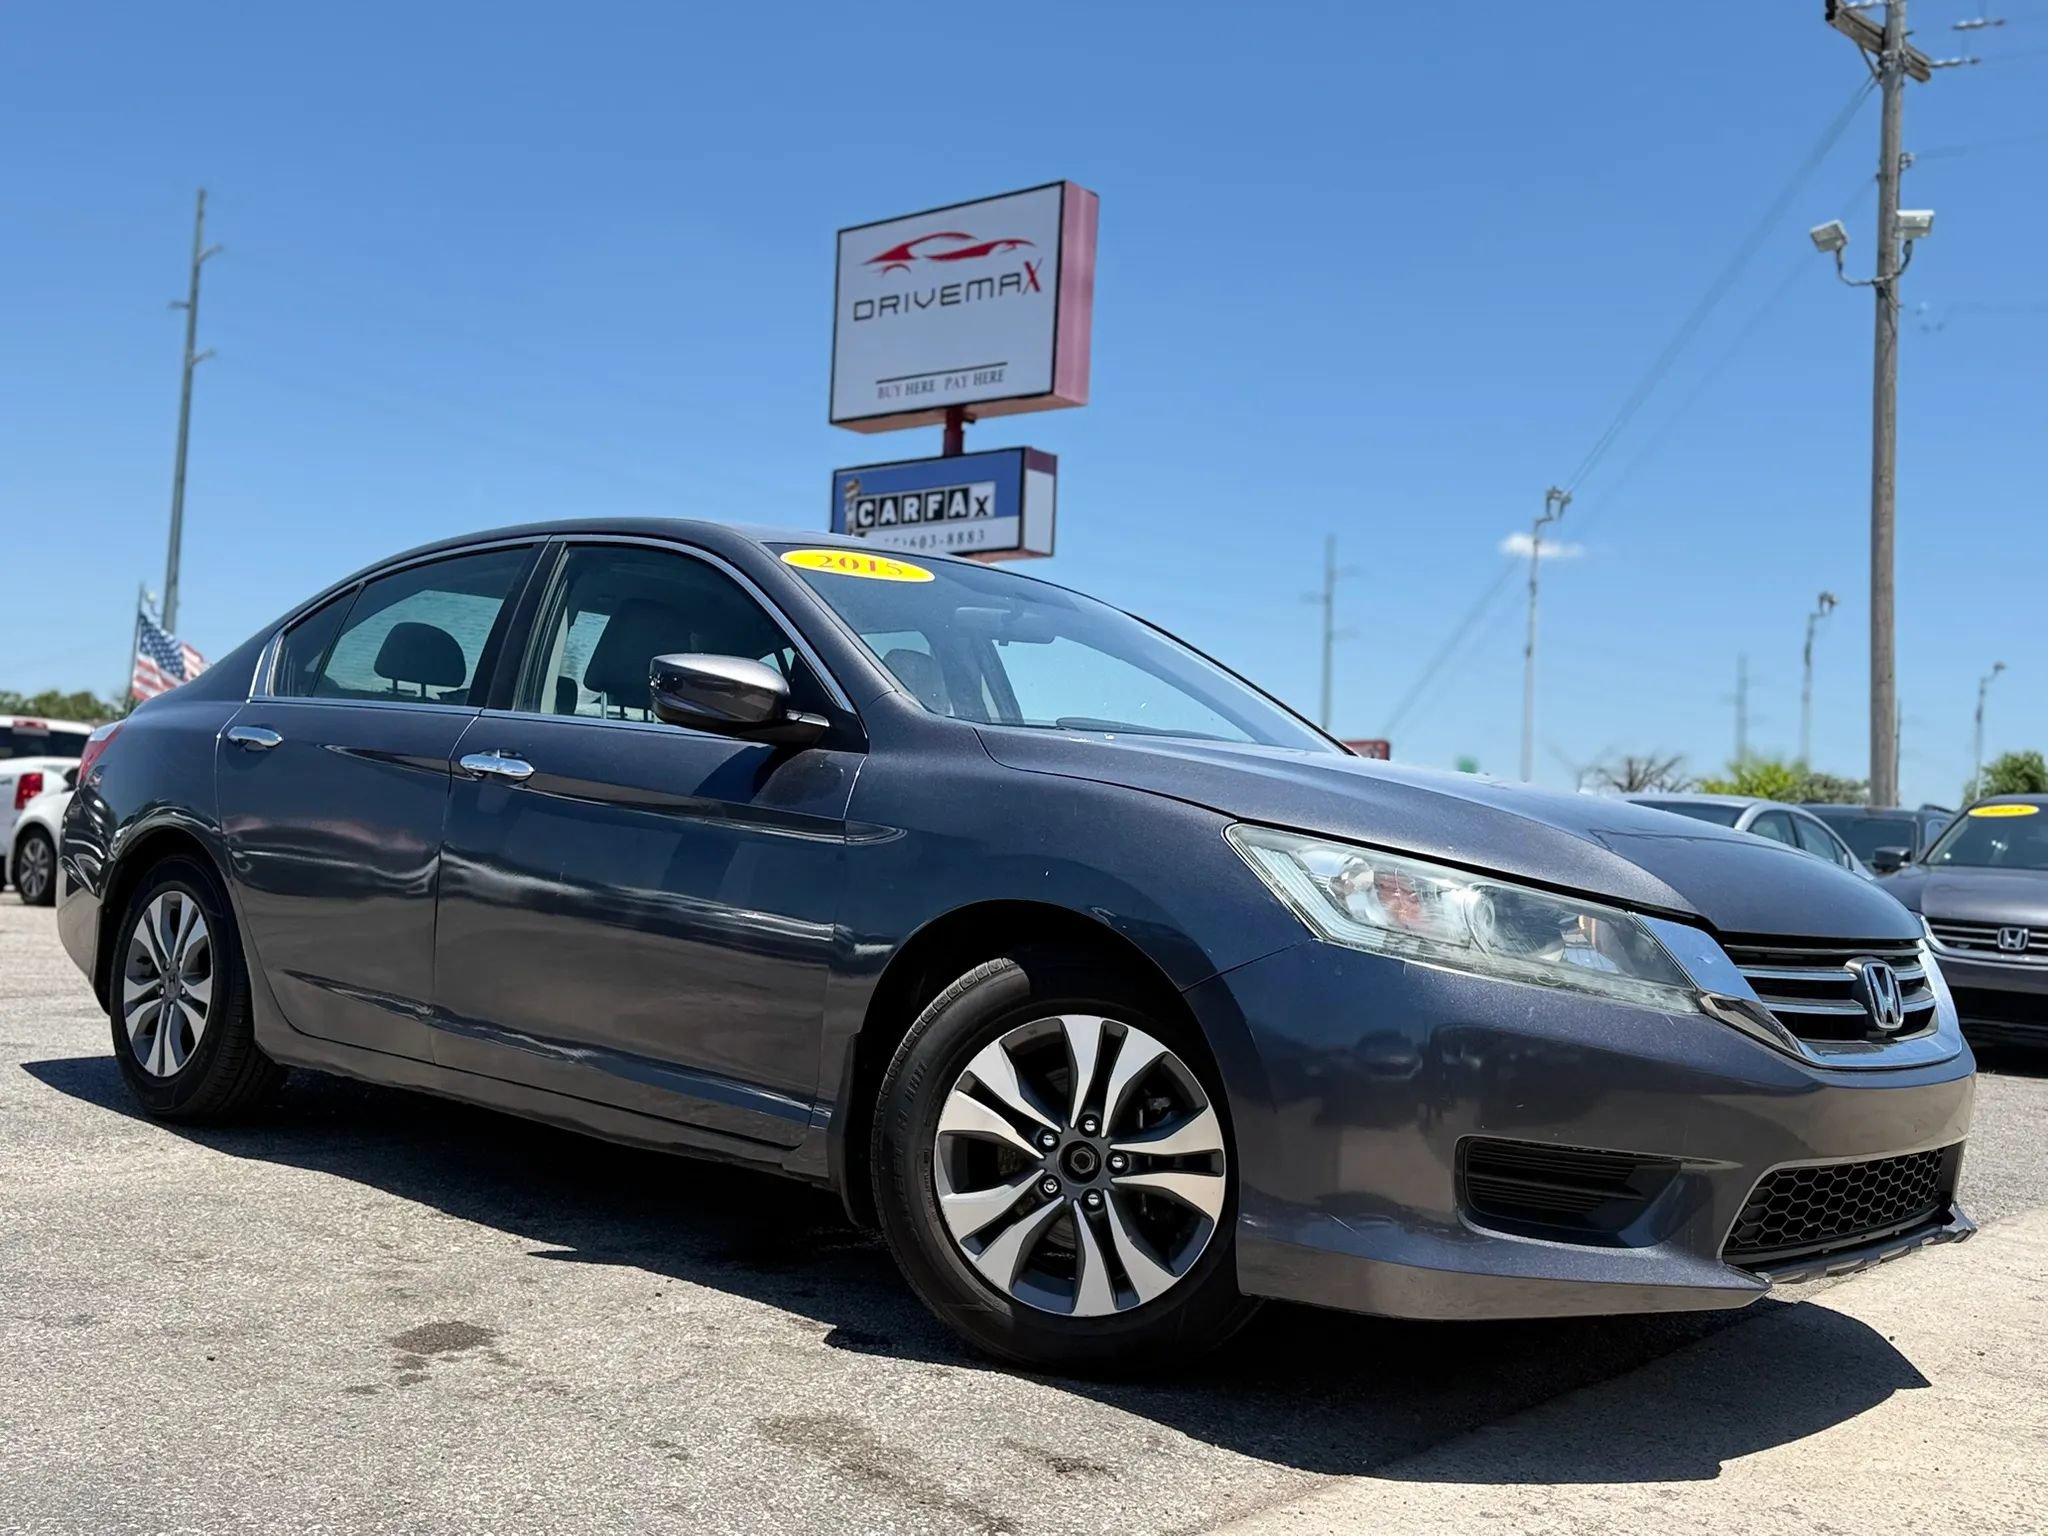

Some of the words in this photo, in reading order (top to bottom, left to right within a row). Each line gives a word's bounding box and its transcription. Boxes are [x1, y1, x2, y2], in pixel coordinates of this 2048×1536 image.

[877, 382, 903, 399] BUY
[905, 379, 936, 396] HERE
[944, 374, 968, 391] PAY
[973, 369, 1005, 386] HERE
[857, 490, 990, 527] CARFAX
[815, 555, 903, 576] 2015
